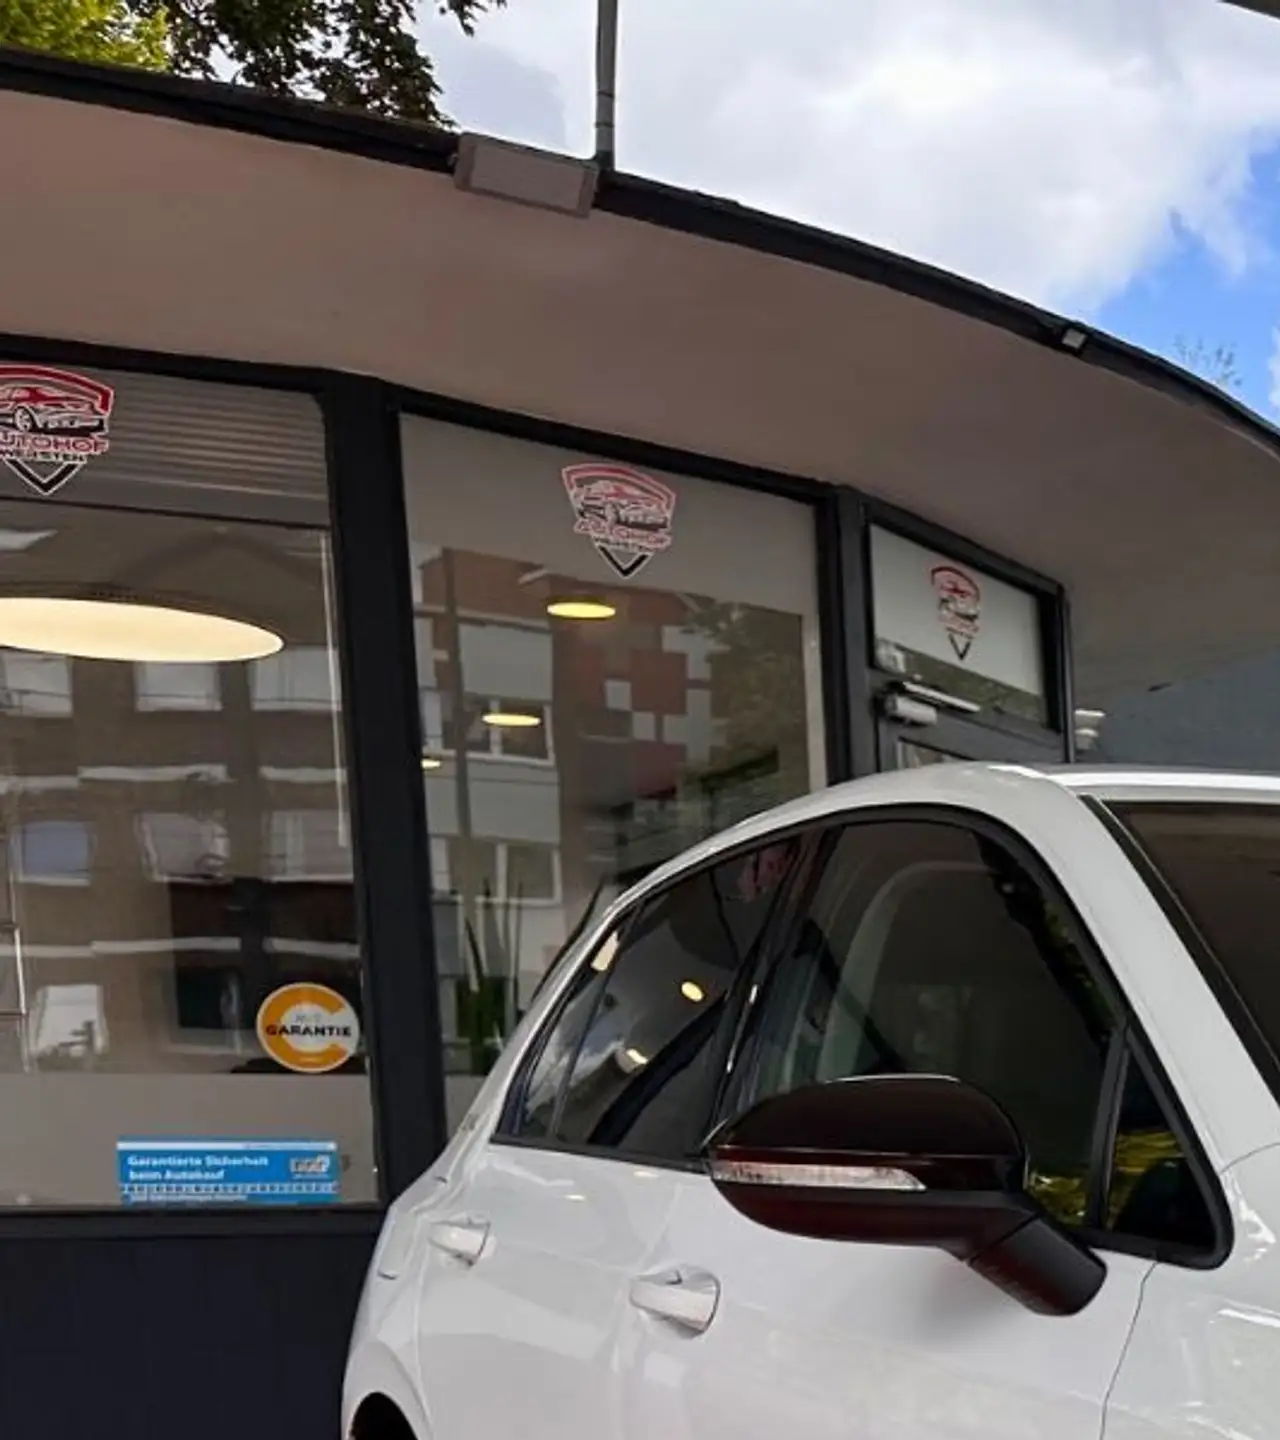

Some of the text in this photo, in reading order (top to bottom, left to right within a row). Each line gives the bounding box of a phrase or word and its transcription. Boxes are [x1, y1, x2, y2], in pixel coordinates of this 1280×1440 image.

[0, 430, 109, 454] UTOHOF
[266, 1024, 352, 1037] GARANTIE
[127, 1155, 203, 1167] Garantierte
